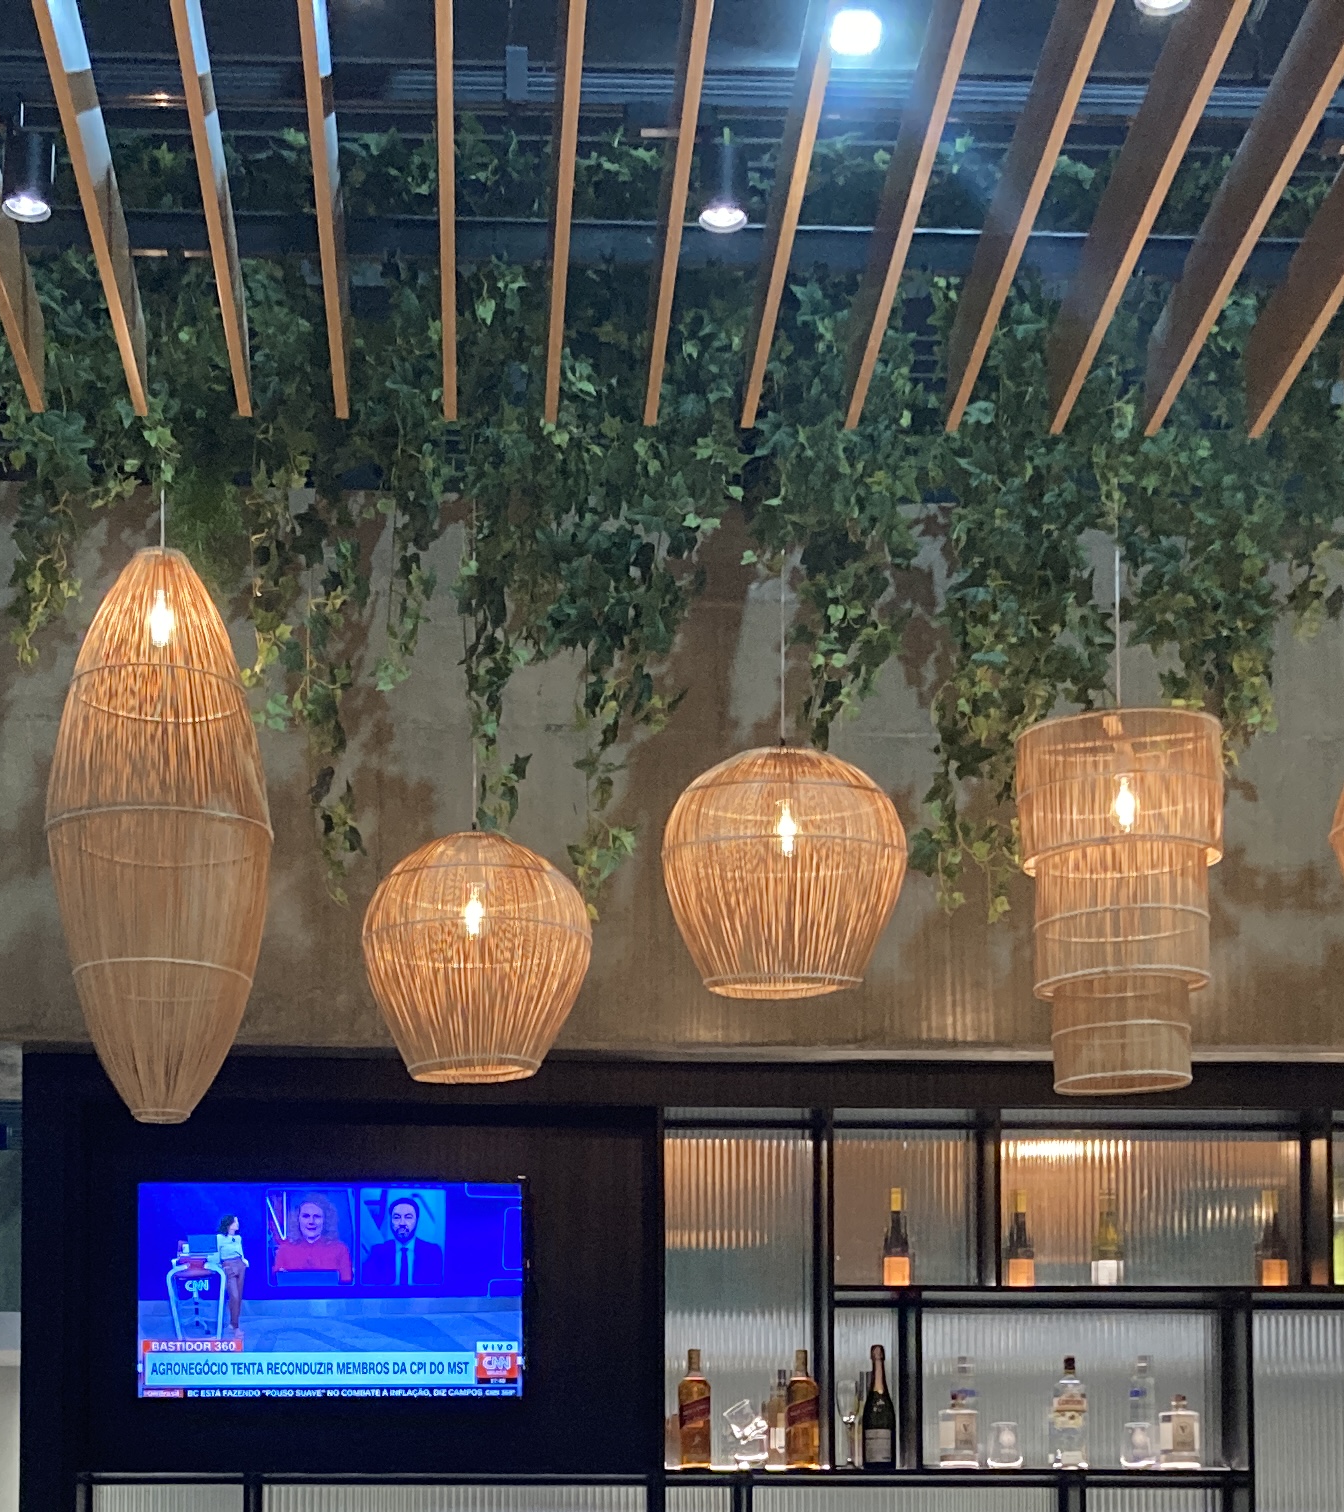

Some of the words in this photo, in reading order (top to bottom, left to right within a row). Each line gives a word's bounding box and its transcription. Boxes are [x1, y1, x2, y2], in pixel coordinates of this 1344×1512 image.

[185, 1280, 209, 1291] CNN
[151, 1341, 211, 1352] BASTIDOR
[215, 1341, 236, 1352] 360
[151, 1359, 228, 1376] AGRONEGÓCIO
[230, 1362, 264, 1375] TENTA
[266, 1362, 333, 1376] RECONDUZIR
[336, 1362, 390, 1375] MEMBROS
[393, 1362, 407, 1375] DA
[410, 1362, 427, 1375] CPI
[429, 1362, 445, 1375] DO
[447, 1361, 470, 1375] MST
[482, 1355, 512, 1371] CNN
